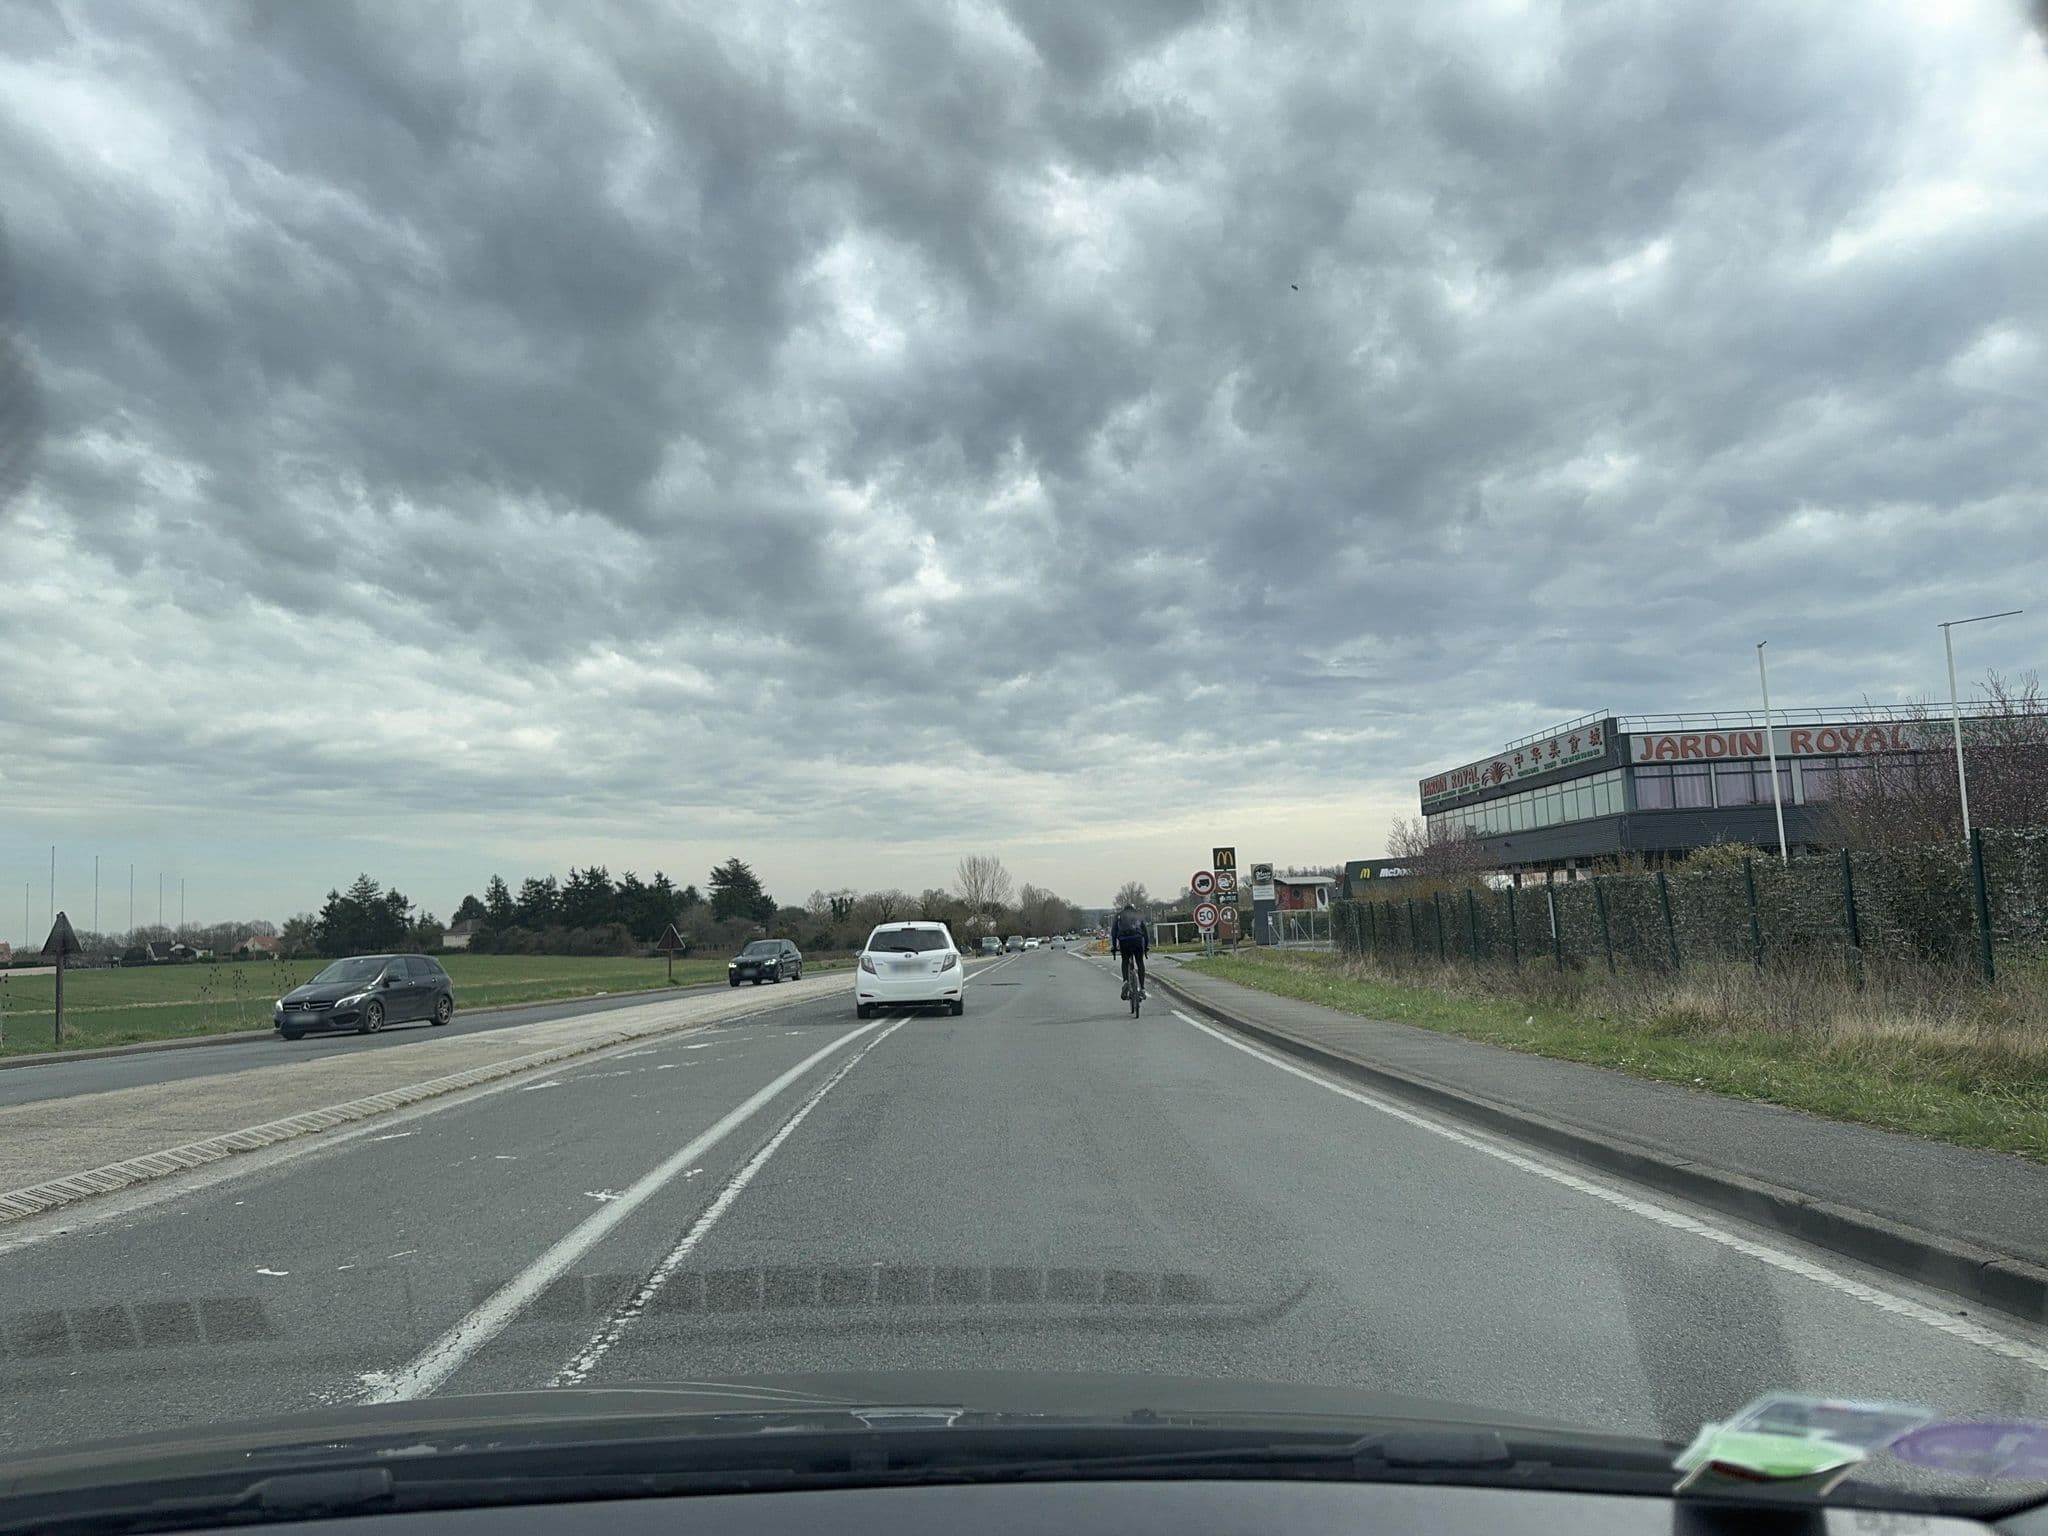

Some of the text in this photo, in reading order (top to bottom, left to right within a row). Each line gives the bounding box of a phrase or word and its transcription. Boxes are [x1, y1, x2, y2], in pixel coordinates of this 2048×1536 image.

[1640, 732, 1763, 760] JARDIN
[1791, 725, 1910, 754] ROYAL
[1451, 766, 1480, 789] ROYAL
[1199, 910, 1214, 922] 50
